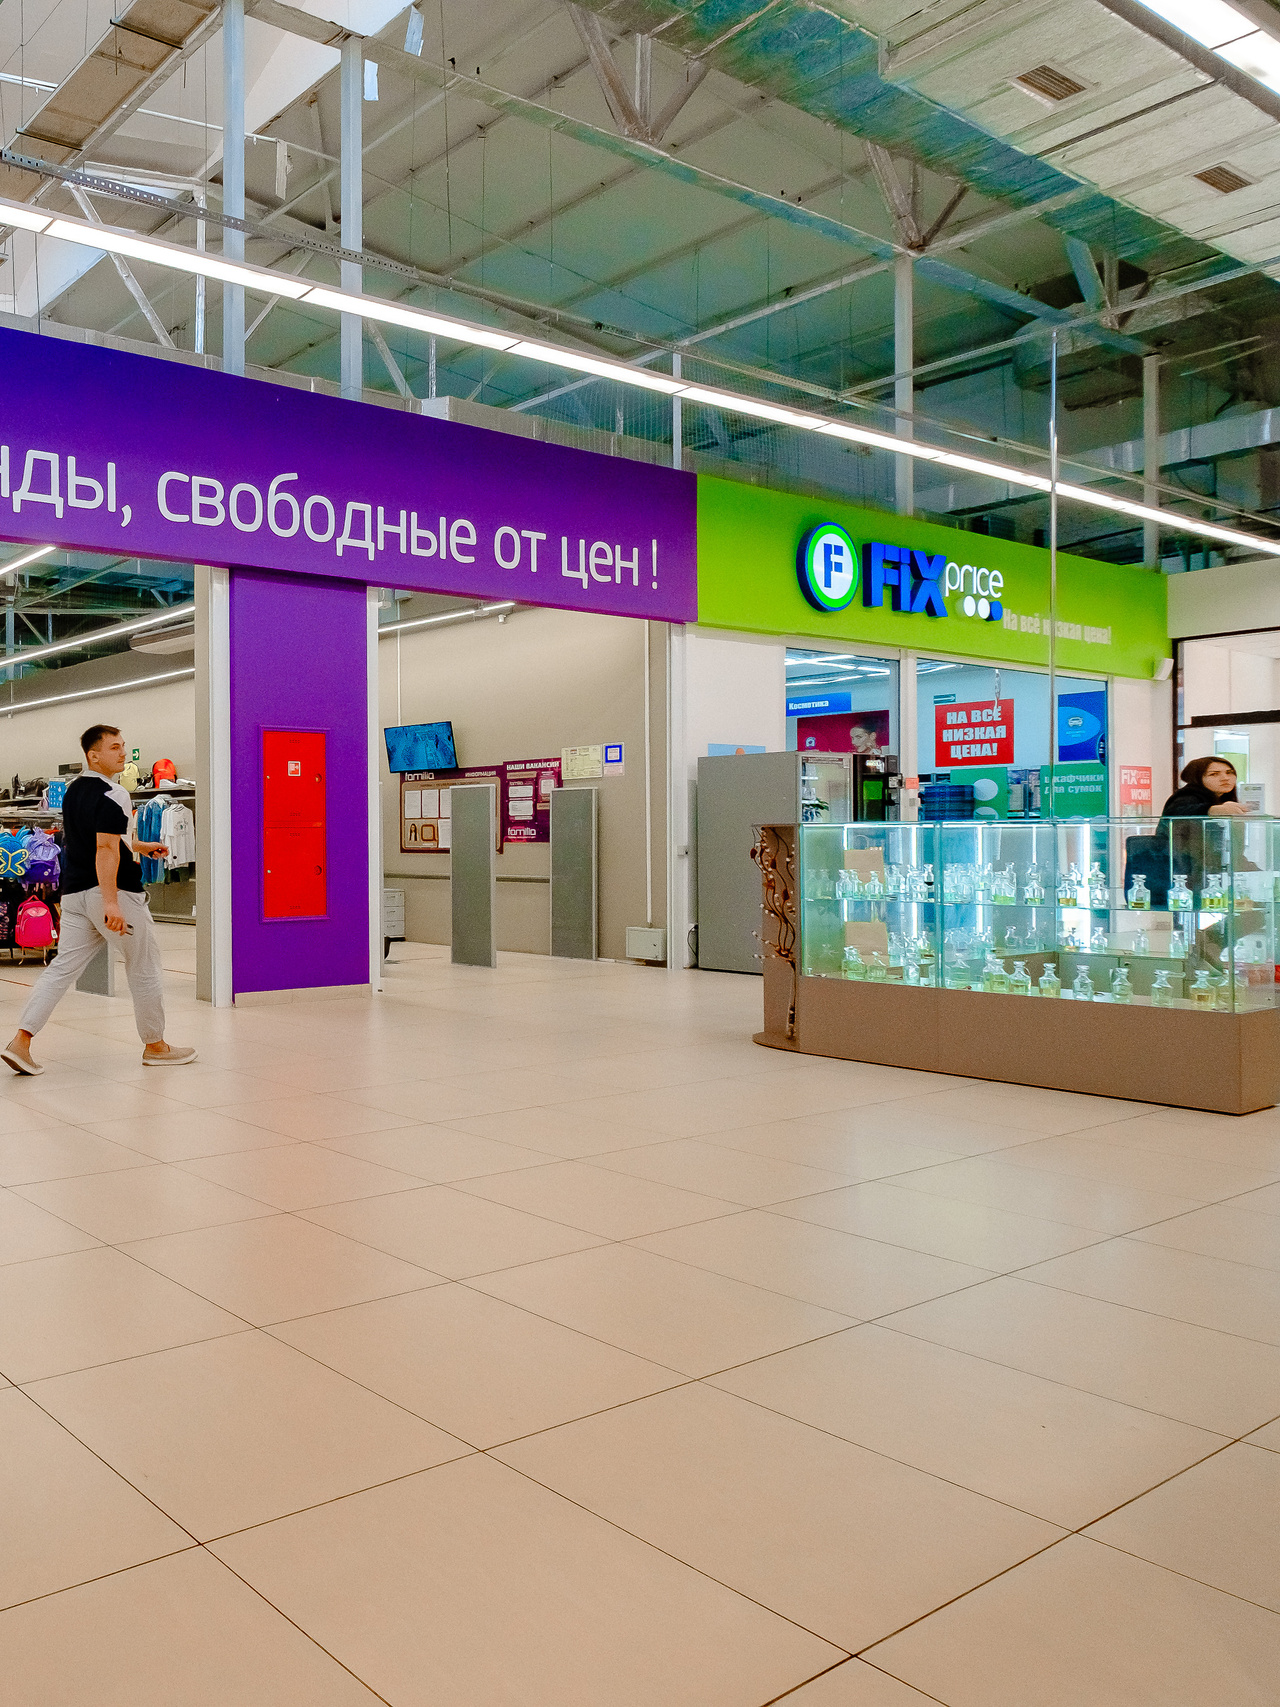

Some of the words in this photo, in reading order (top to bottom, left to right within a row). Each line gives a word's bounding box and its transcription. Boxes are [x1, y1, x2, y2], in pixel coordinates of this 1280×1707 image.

[157, 471, 477, 561] свободные
[493, 525, 547, 573] от
[944, 561, 1004, 598] price
[1003, 608, 1018, 631] На
[1020, 612, 1040, 635] всё
[1084, 625, 1112, 645] цена!
[946, 710, 968, 725] НА
[942, 725, 1007, 742] НИЗКАЯ
[950, 743, 998, 759] ЦЕНА!
[526, 761, 559, 769] ВАКАНСИИ
[405, 772, 434, 781] familia
[1068, 785, 1102, 793] сумок
[1131, 788, 1150, 800] WOW!
[508, 827, 536, 835] familia
